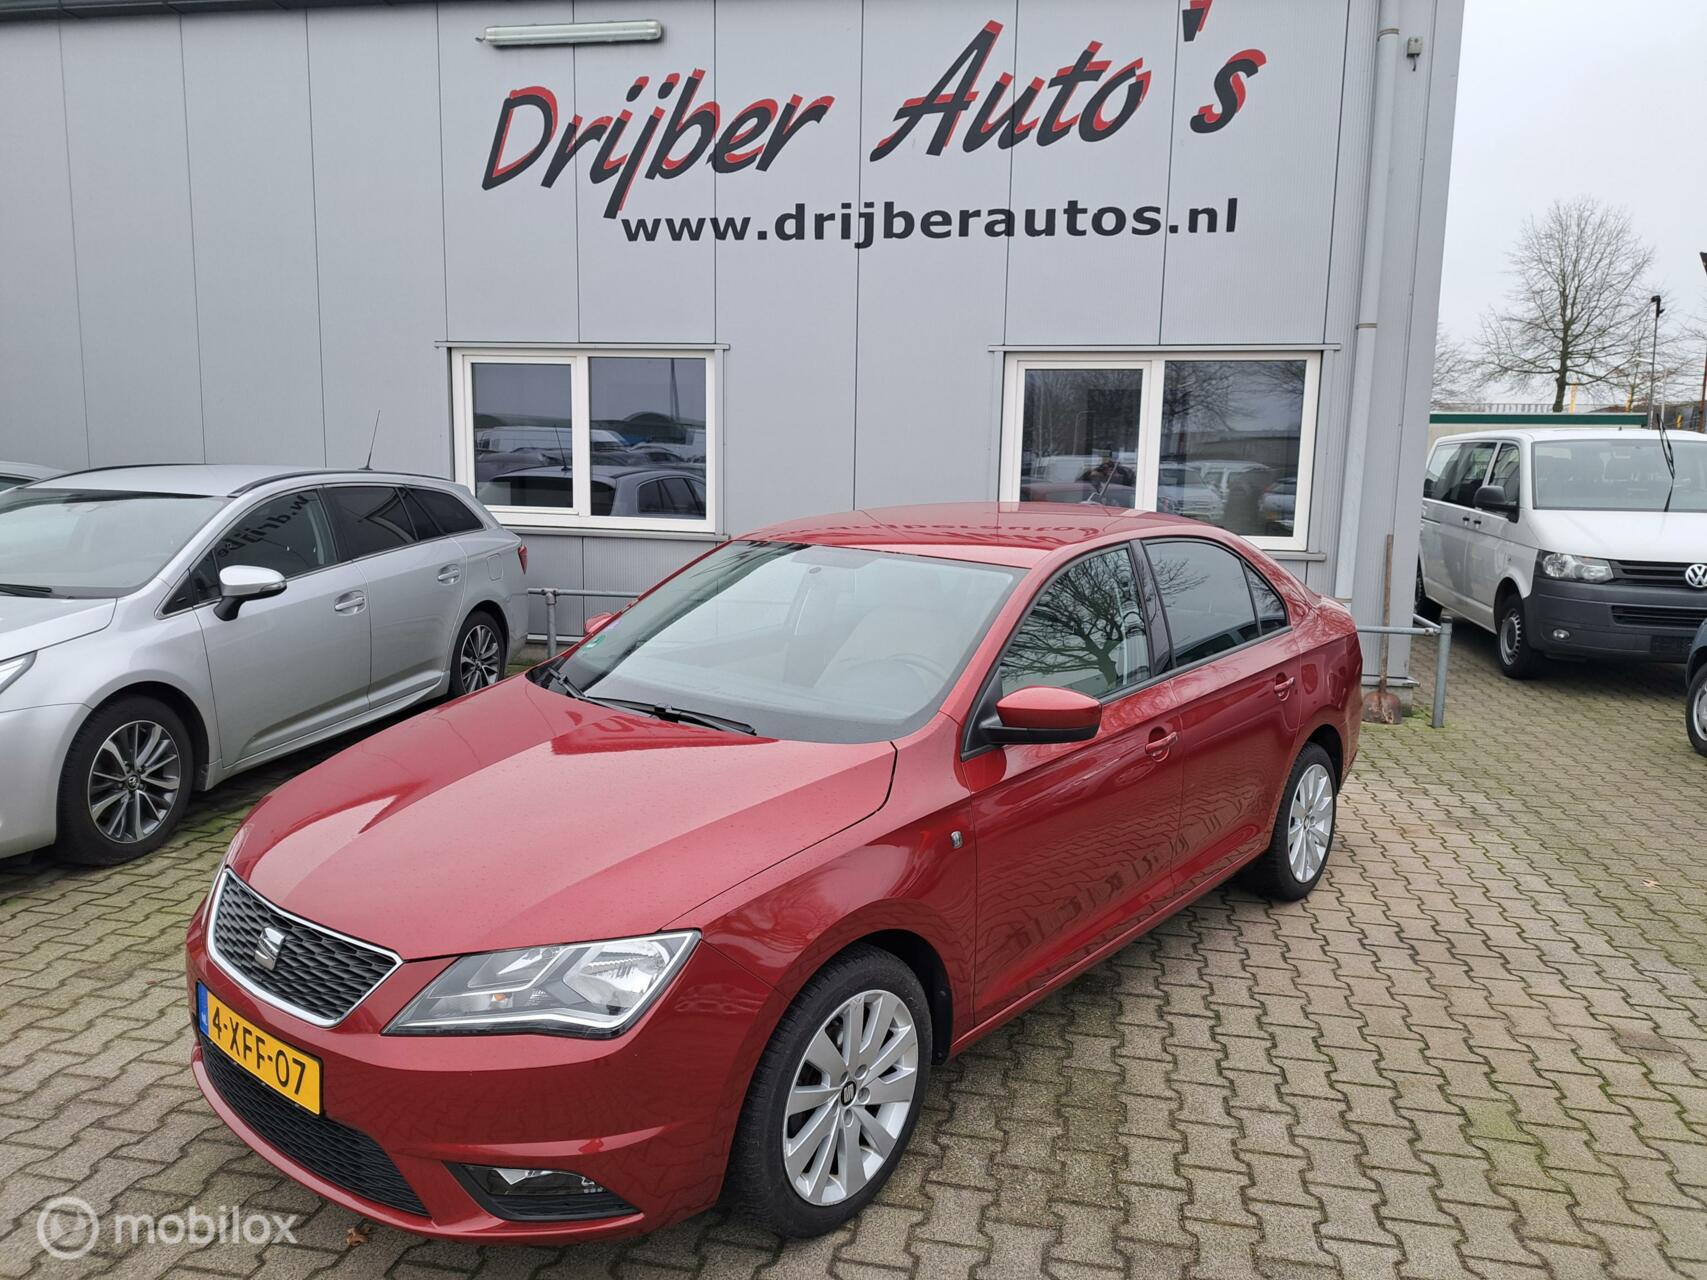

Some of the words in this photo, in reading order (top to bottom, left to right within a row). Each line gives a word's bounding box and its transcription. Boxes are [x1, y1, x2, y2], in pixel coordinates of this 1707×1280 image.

[481, 68, 834, 220] Drijber
[870, 0, 1267, 162] Auto's
[621, 197, 1238, 250] www.drijberautos.nl
[212, 1006, 307, 1096] 4-XFF-07
